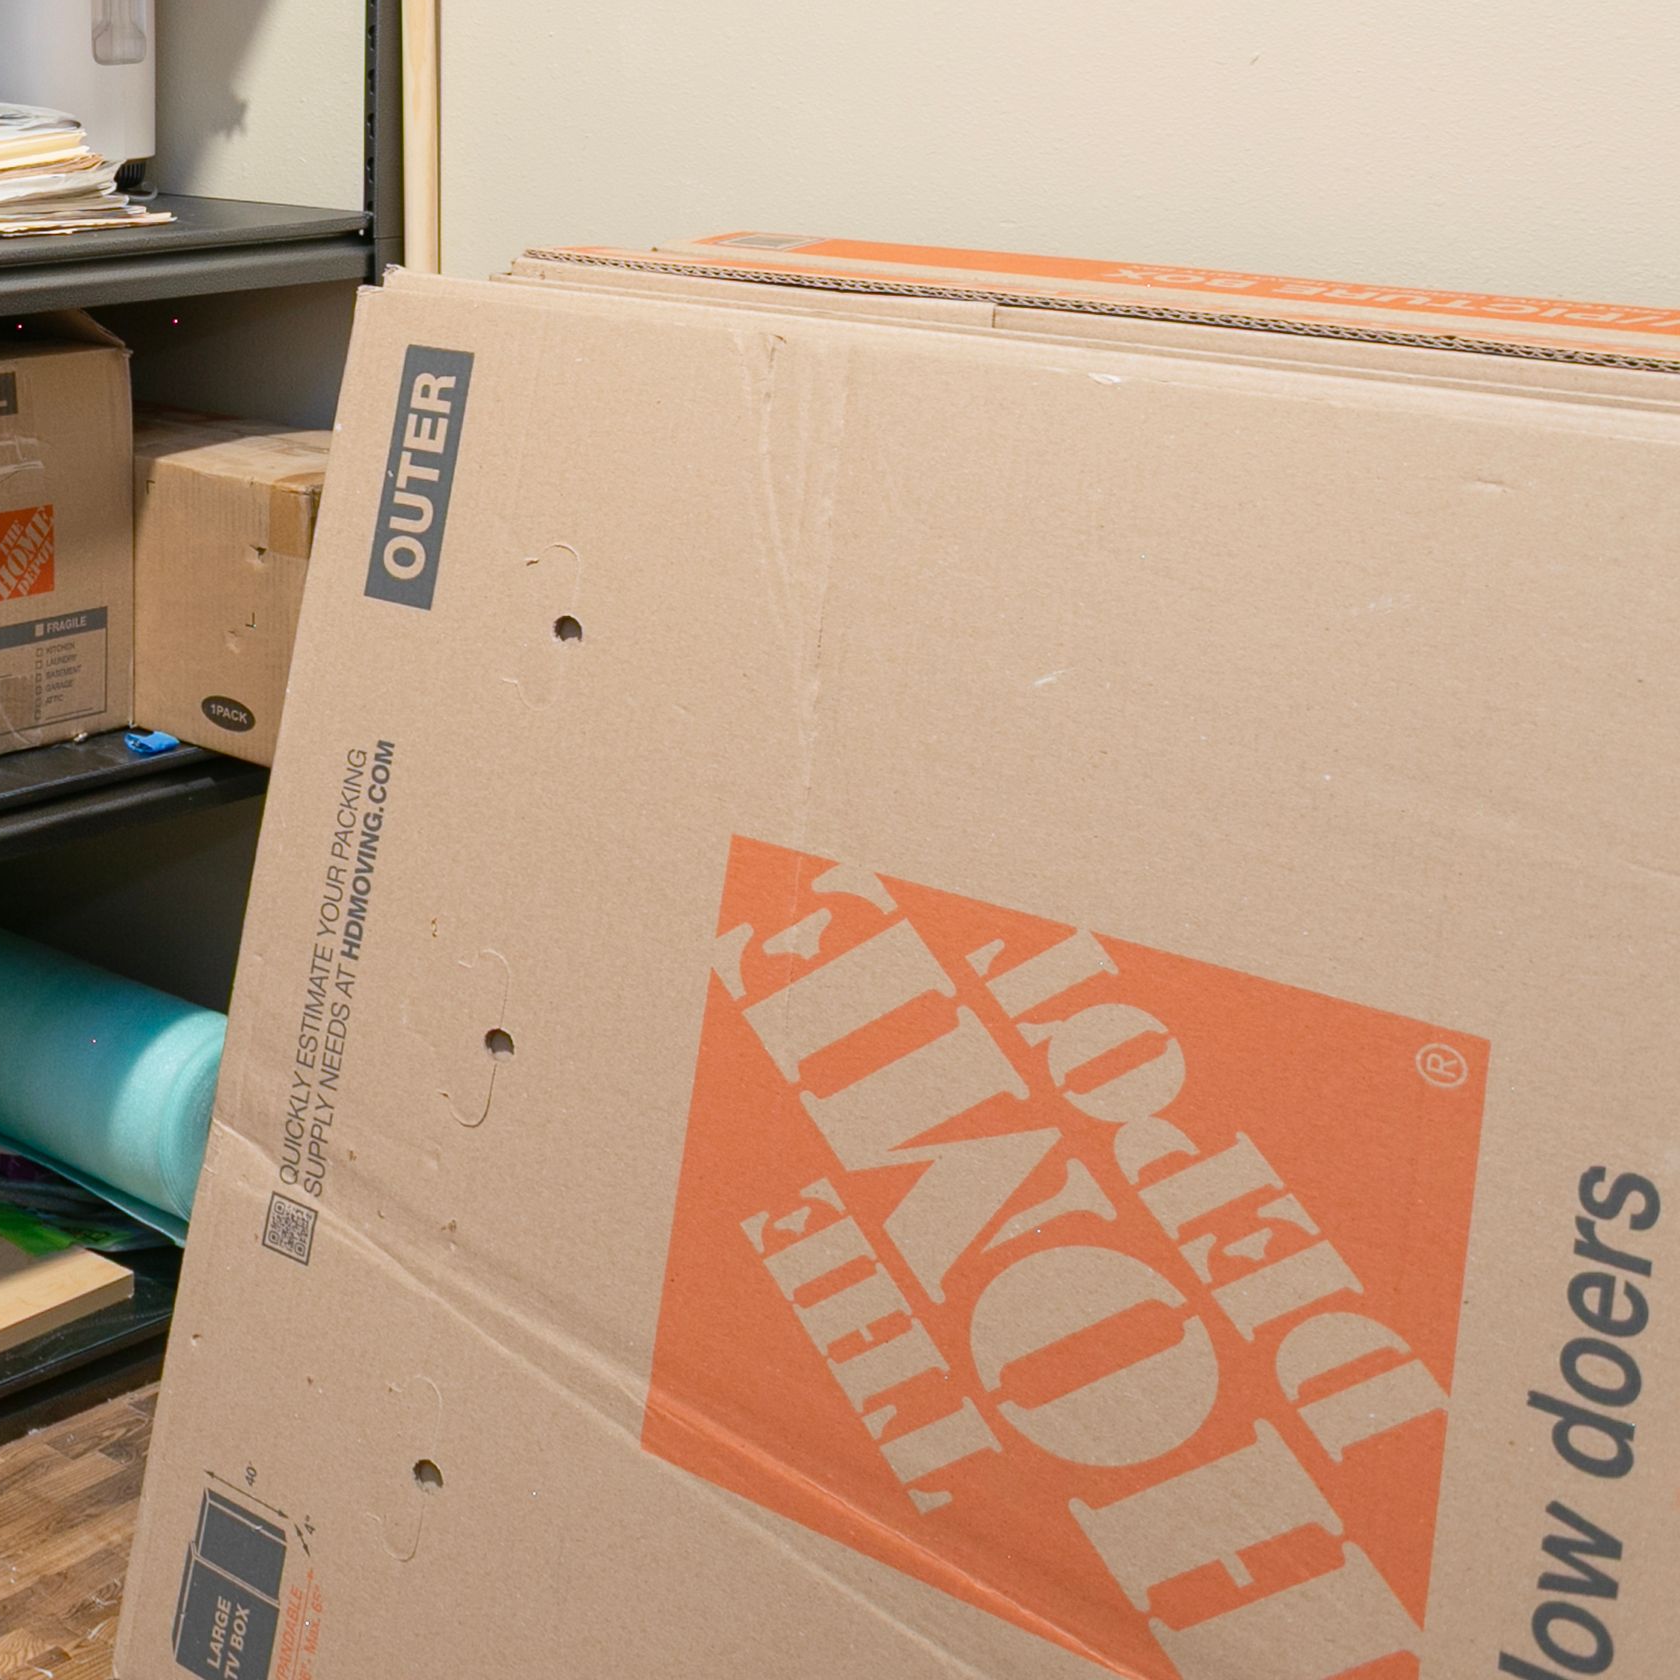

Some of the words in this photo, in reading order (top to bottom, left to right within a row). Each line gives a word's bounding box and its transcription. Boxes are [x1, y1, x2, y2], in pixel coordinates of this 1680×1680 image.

[1103, 269, 1267, 295] BOX
[383, 372, 456, 580] OUTER
[17, 538, 54, 597] DEPOT
[47, 616, 87, 633] FRAGILE
[210, 704, 248, 725] 1PACK
[332, 748, 368, 863] PACKING
[341, 739, 396, 961] HDMOVING.COM
[317, 864, 348, 938] YOUR
[296, 942, 333, 1070] ESTIMATE
[335, 970, 358, 1000] AT
[321, 1002, 352, 1091] NEEDS
[279, 1071, 313, 1186] QUICKLY
[303, 1093, 336, 1198] SUPPLY
[965, 929, 1451, 1463] DEPOT
[709, 863, 1426, 1680] HOME
[739, 1178, 1003, 1514] THE
[1527, 1165, 1661, 1479] doers
[207, 1596, 231, 1670] LARGE
[224, 1652, 241, 1680] TV
[230, 1603, 251, 1652] BOX
[276, 1586, 303, 1680] PANDABLE
